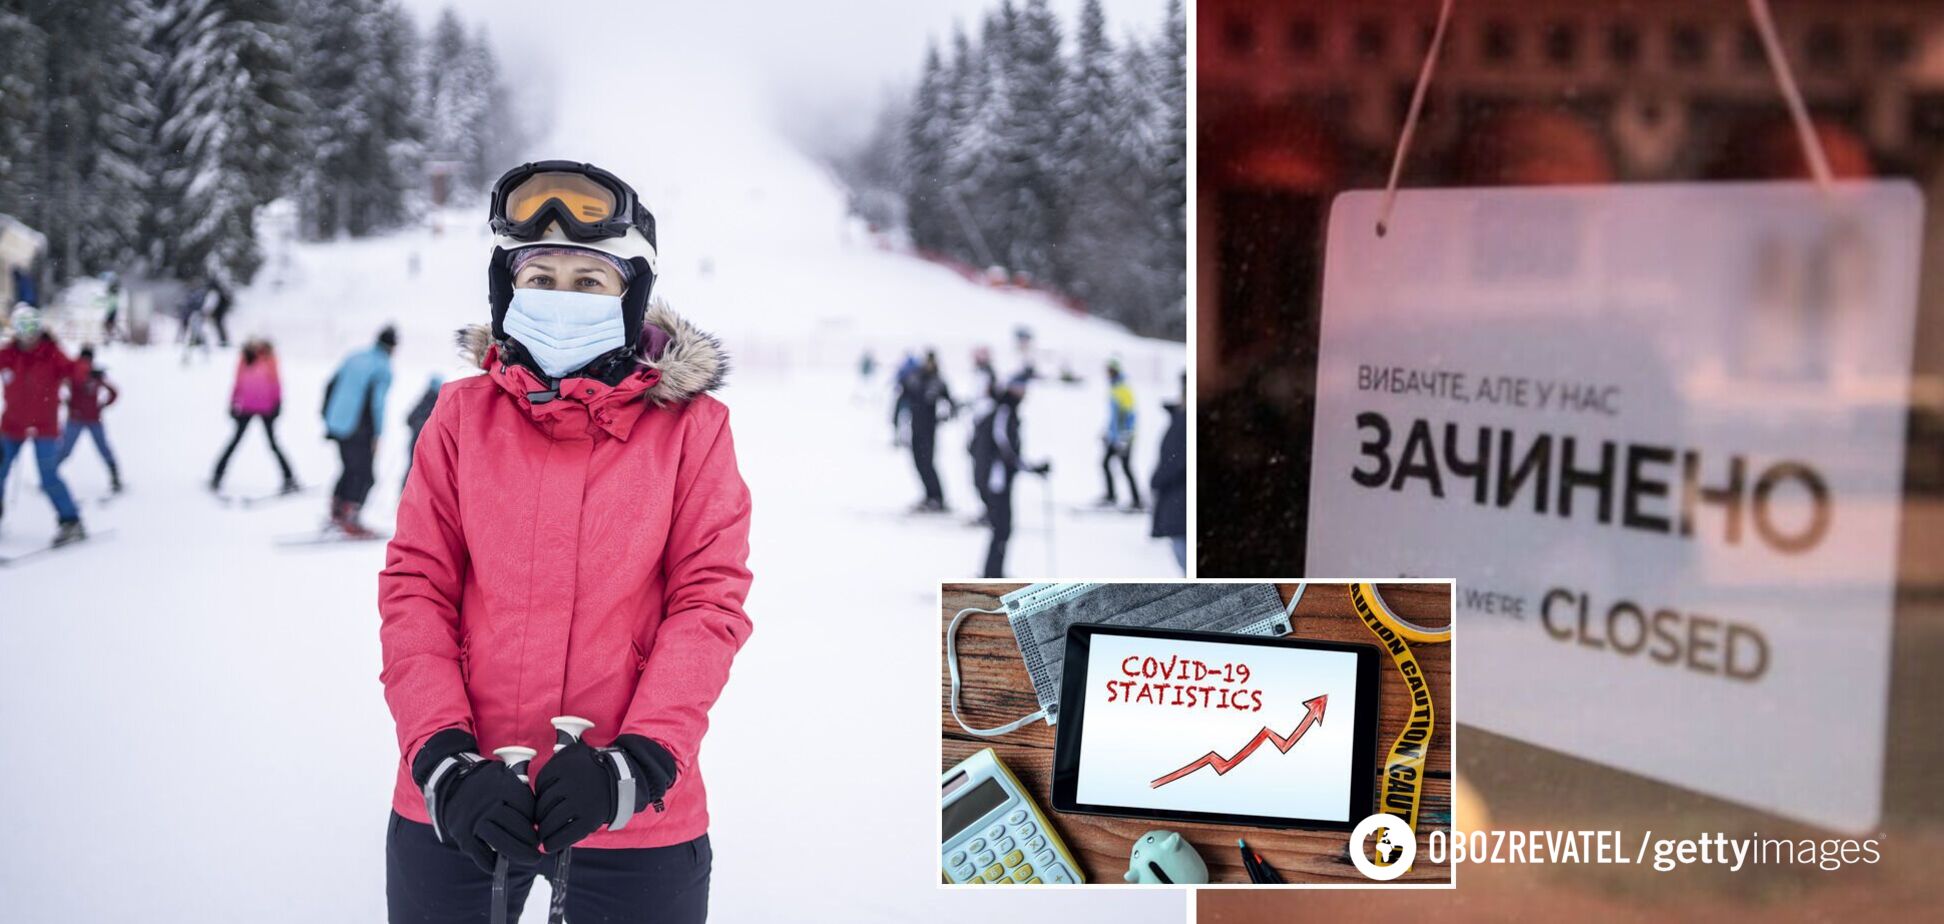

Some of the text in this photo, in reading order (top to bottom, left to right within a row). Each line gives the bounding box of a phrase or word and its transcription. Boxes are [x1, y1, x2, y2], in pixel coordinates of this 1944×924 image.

[1357, 364, 1622, 416] ВИБАЧТЕ, АЛЕ У НАС
[1351, 411, 1834, 555] ЗАЧИНЕНО
[1121, 655, 1251, 684] COVID-19
[1351, 583, 1405, 656] AUTION
[1394, 660, 1431, 760] CAUTION
[1540, 587, 1772, 683] CLOSED
[1106, 680, 1263, 712] STATISTICS
